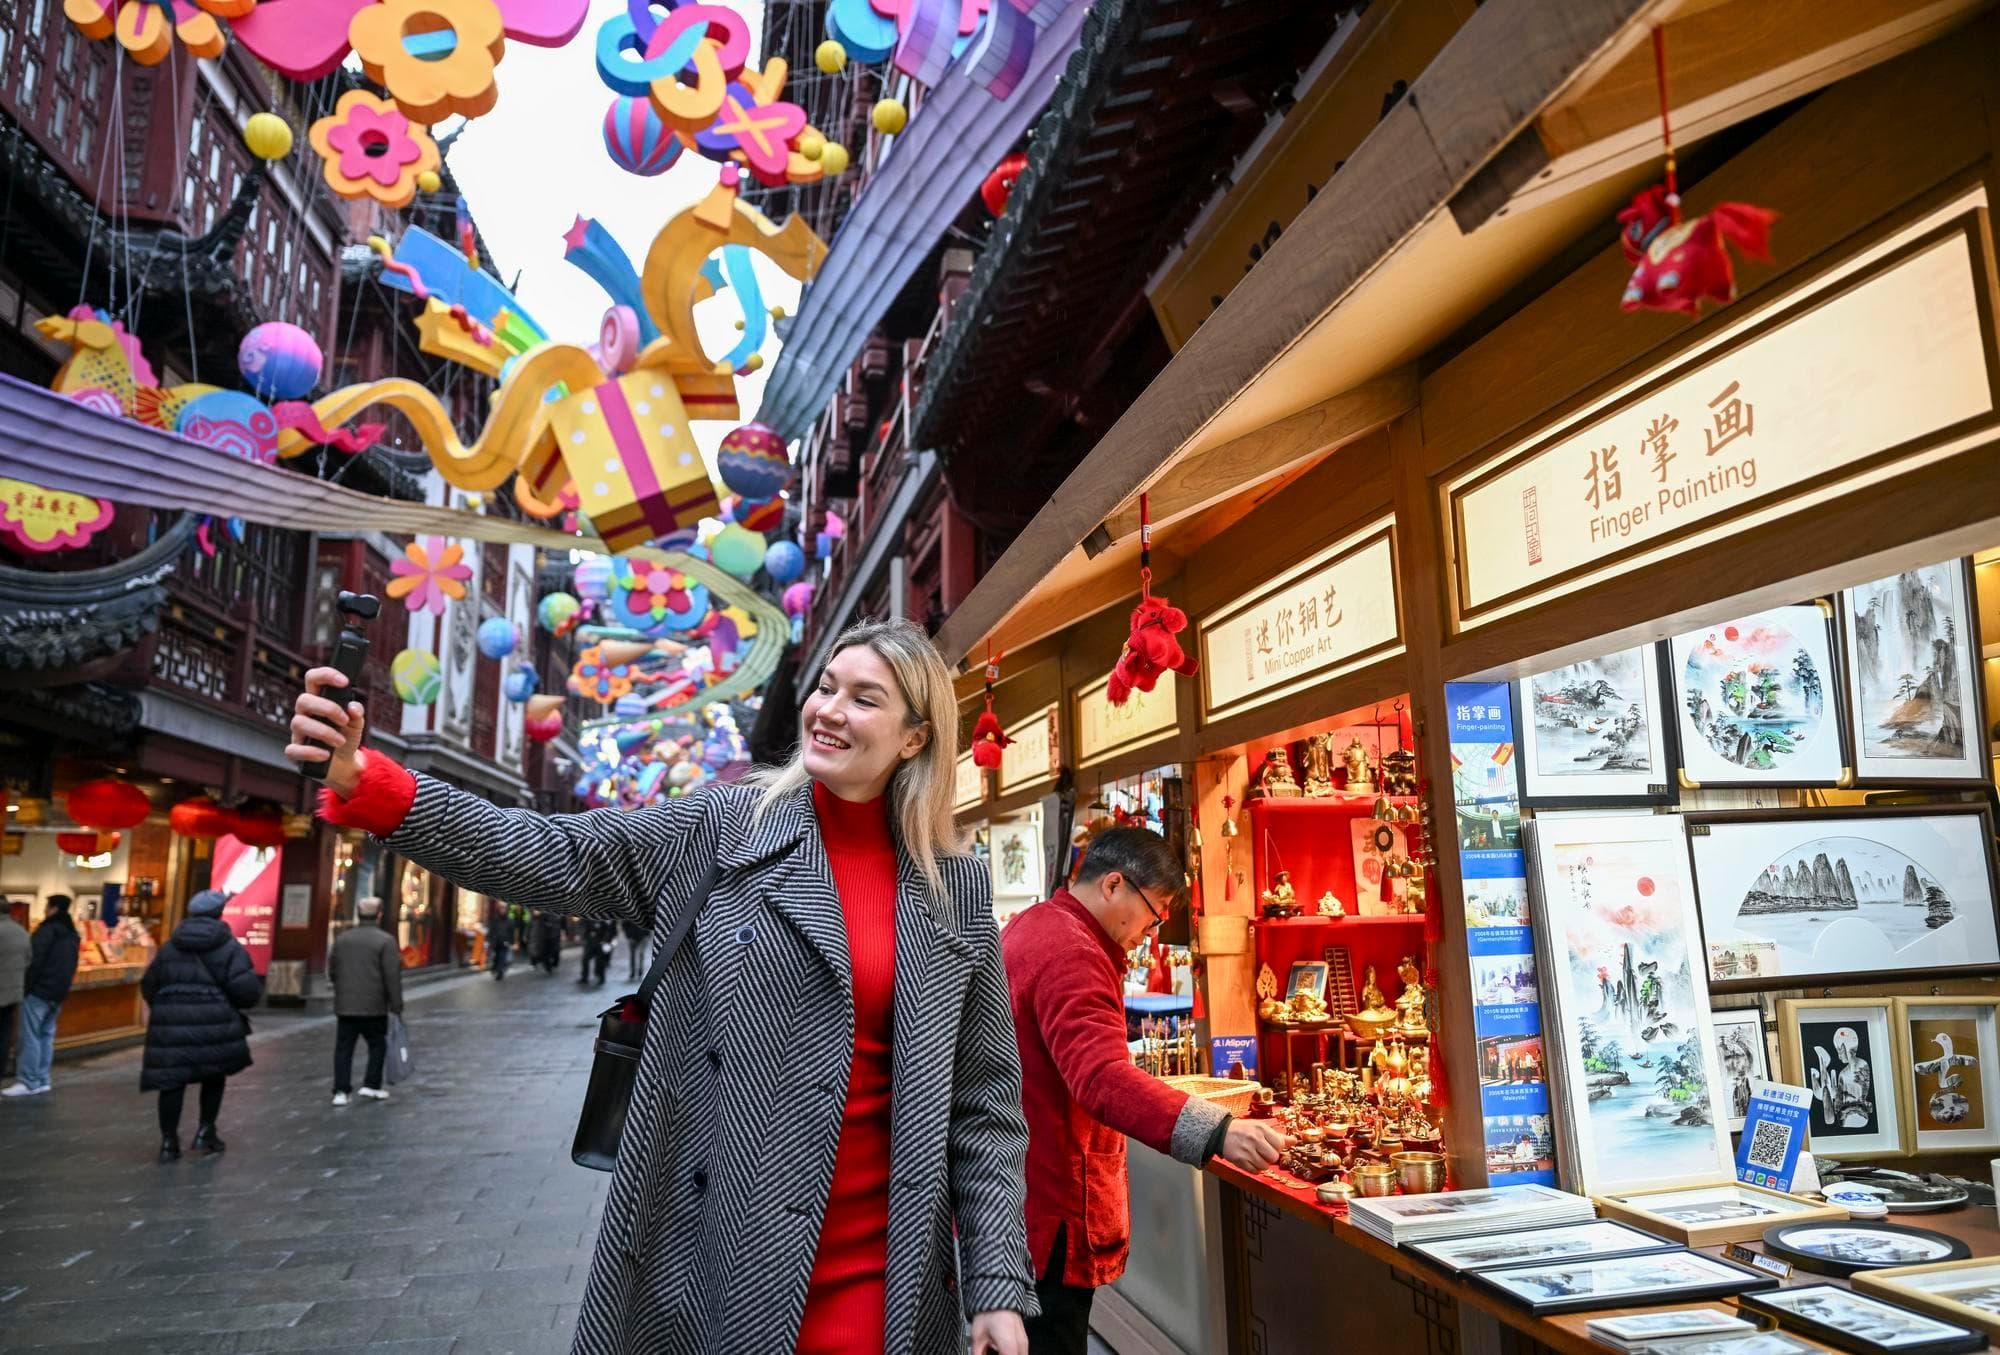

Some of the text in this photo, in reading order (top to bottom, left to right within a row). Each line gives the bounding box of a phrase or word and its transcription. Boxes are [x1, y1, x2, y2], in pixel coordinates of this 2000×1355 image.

[1584, 380, 1754, 508] 指掌画
[1589, 501, 1653, 543] Finger
[1658, 457, 1758, 519] Painting
[1255, 584, 1343, 654] 迷你铜艺
[1264, 655, 1282, 677] Mini
[1283, 643, 1315, 669] Copper
[1317, 635, 1333, 654] Art
[1456, 705, 1501, 720] 指掌画
[1456, 723, 1505, 731] Finger-painting
[1713, 971, 1726, 981] 20
[1759, 1256, 1782, 1270] Avatar
